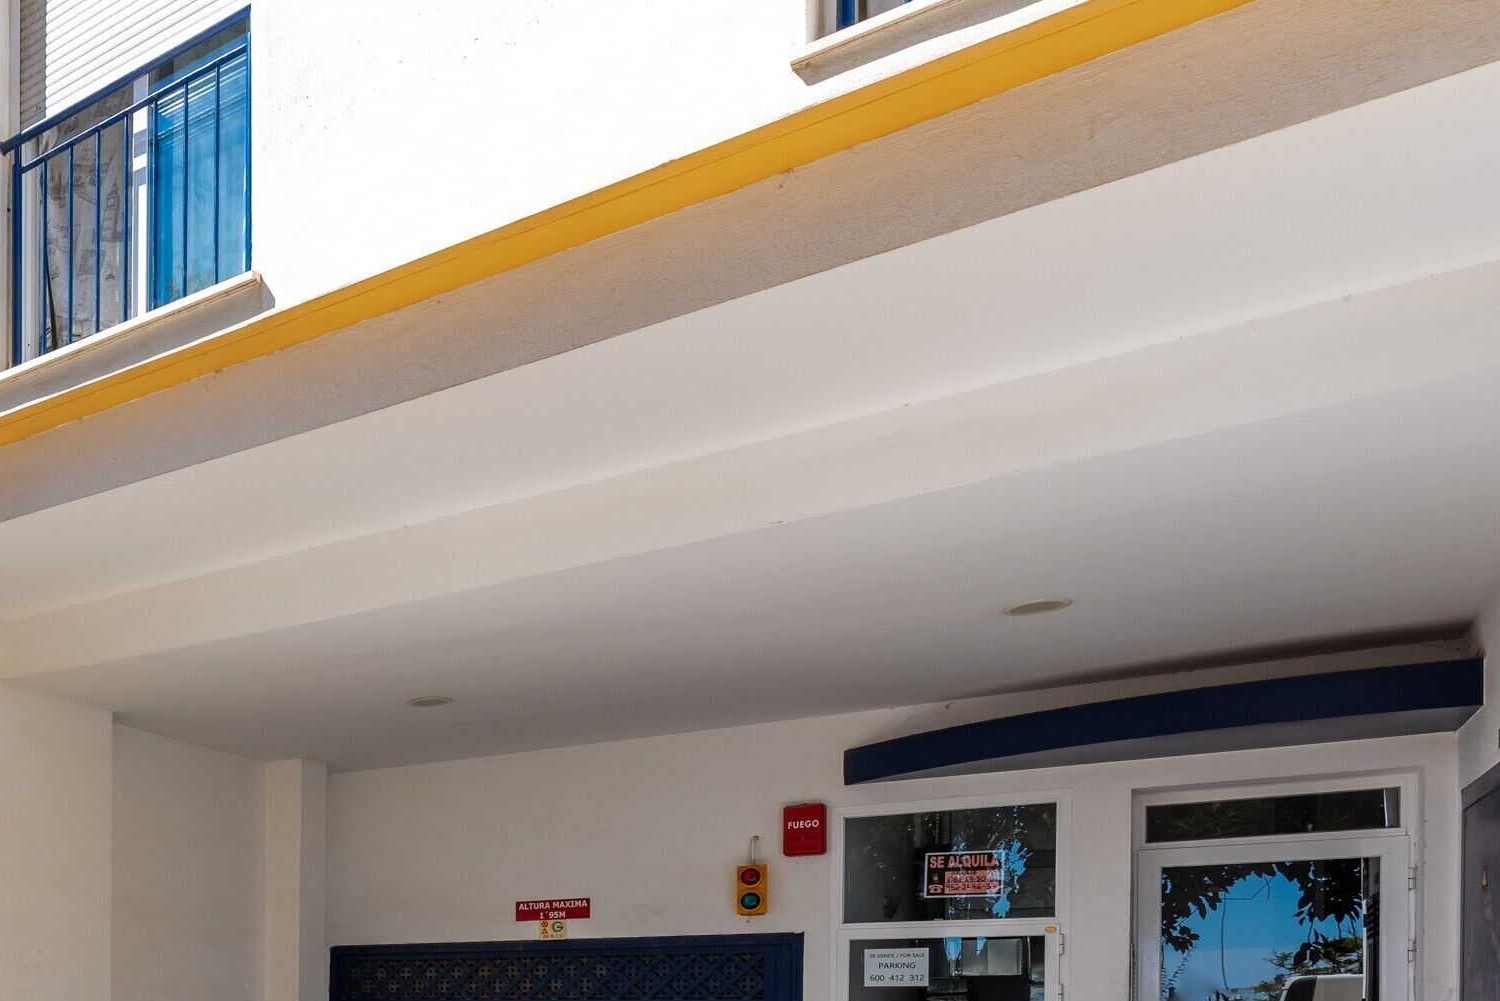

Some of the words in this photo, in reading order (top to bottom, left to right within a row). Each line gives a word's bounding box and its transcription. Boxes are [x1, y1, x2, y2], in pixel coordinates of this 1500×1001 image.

[787, 819, 820, 830] FUEGO
[929, 855, 945, 869] SE
[947, 854, 1000, 868] ALQUILA
[518, 902, 550, 911] ALTURA
[552, 899, 588, 909] MAXIMA
[870, 974, 885, 982] 600
[889, 974, 905, 982] 412
[909, 974, 925, 982] 312
